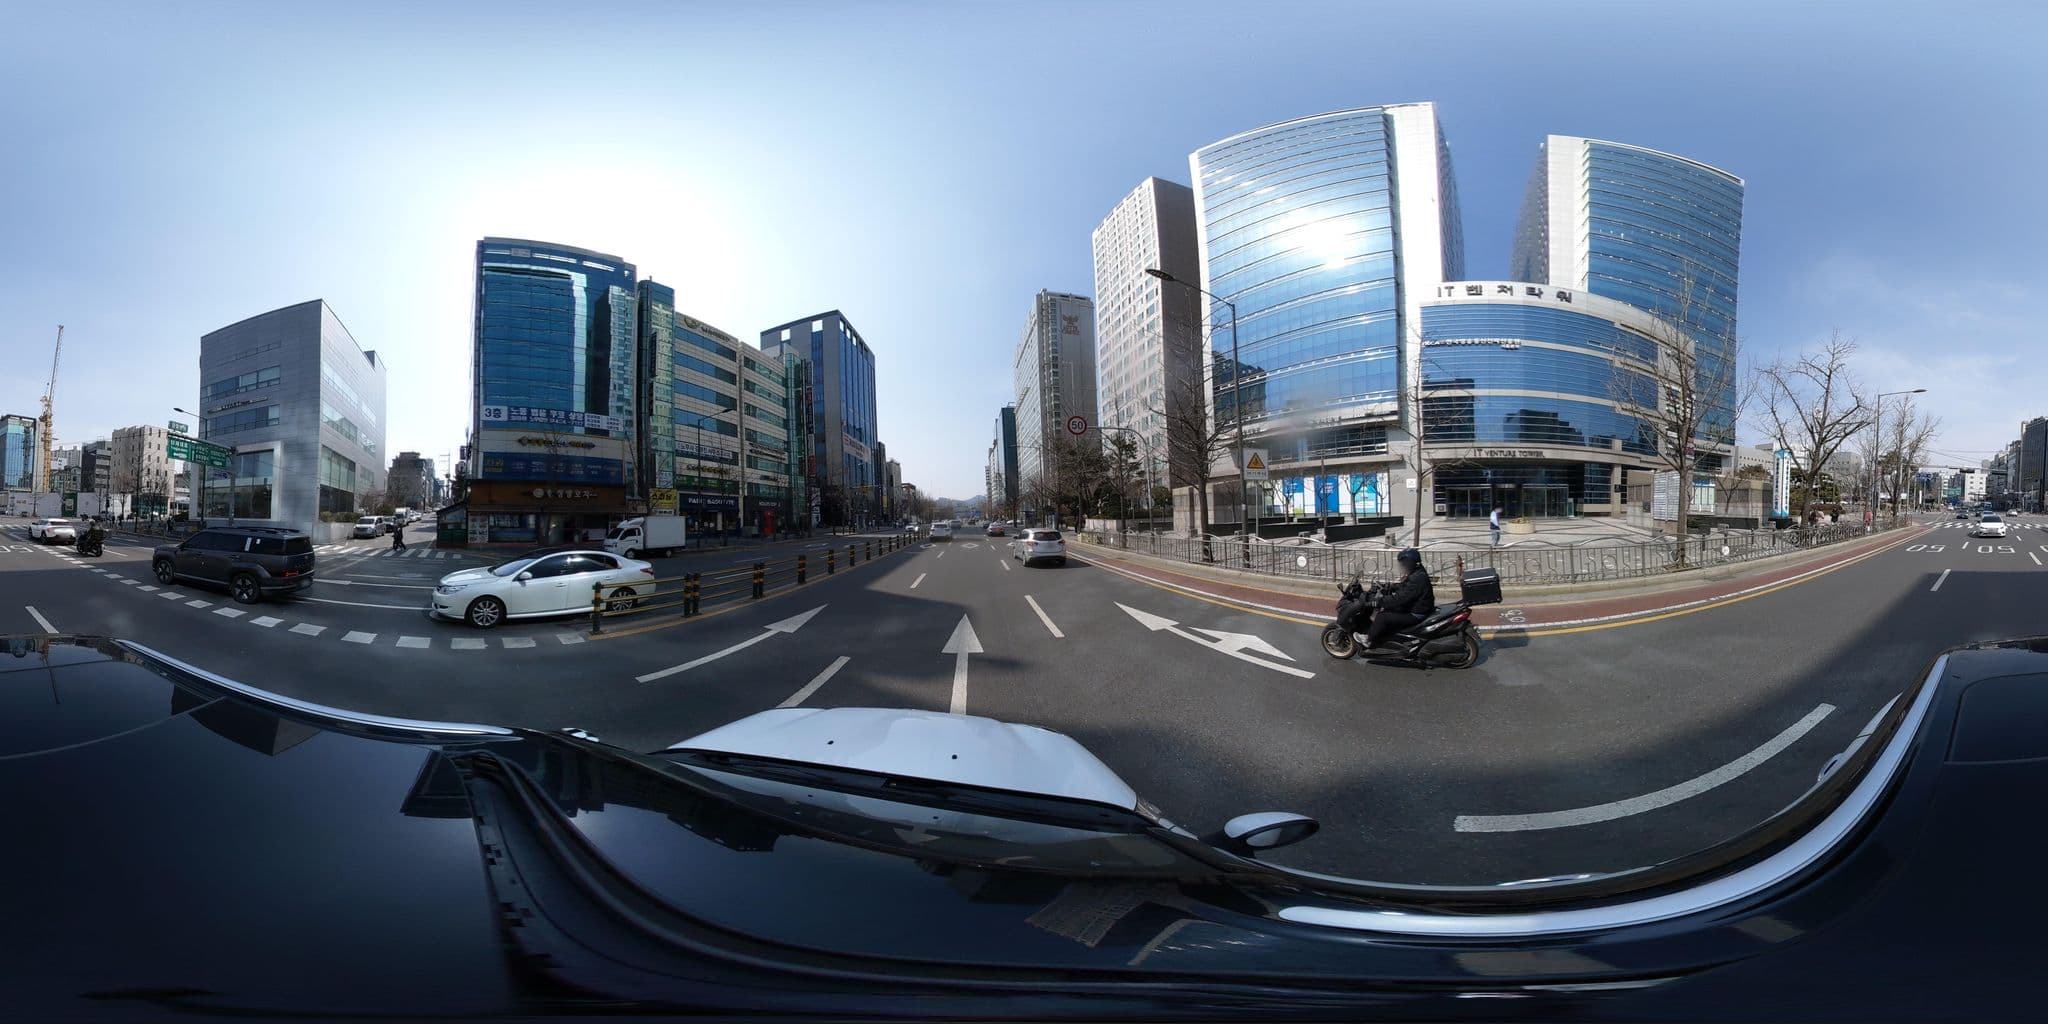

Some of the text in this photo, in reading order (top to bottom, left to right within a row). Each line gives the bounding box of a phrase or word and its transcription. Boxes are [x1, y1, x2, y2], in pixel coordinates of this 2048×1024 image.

[1437, 284, 1572, 304] IT 벤처타워
[1071, 420, 1084, 430] 50
[1473, 448, 1483, 457] IT
